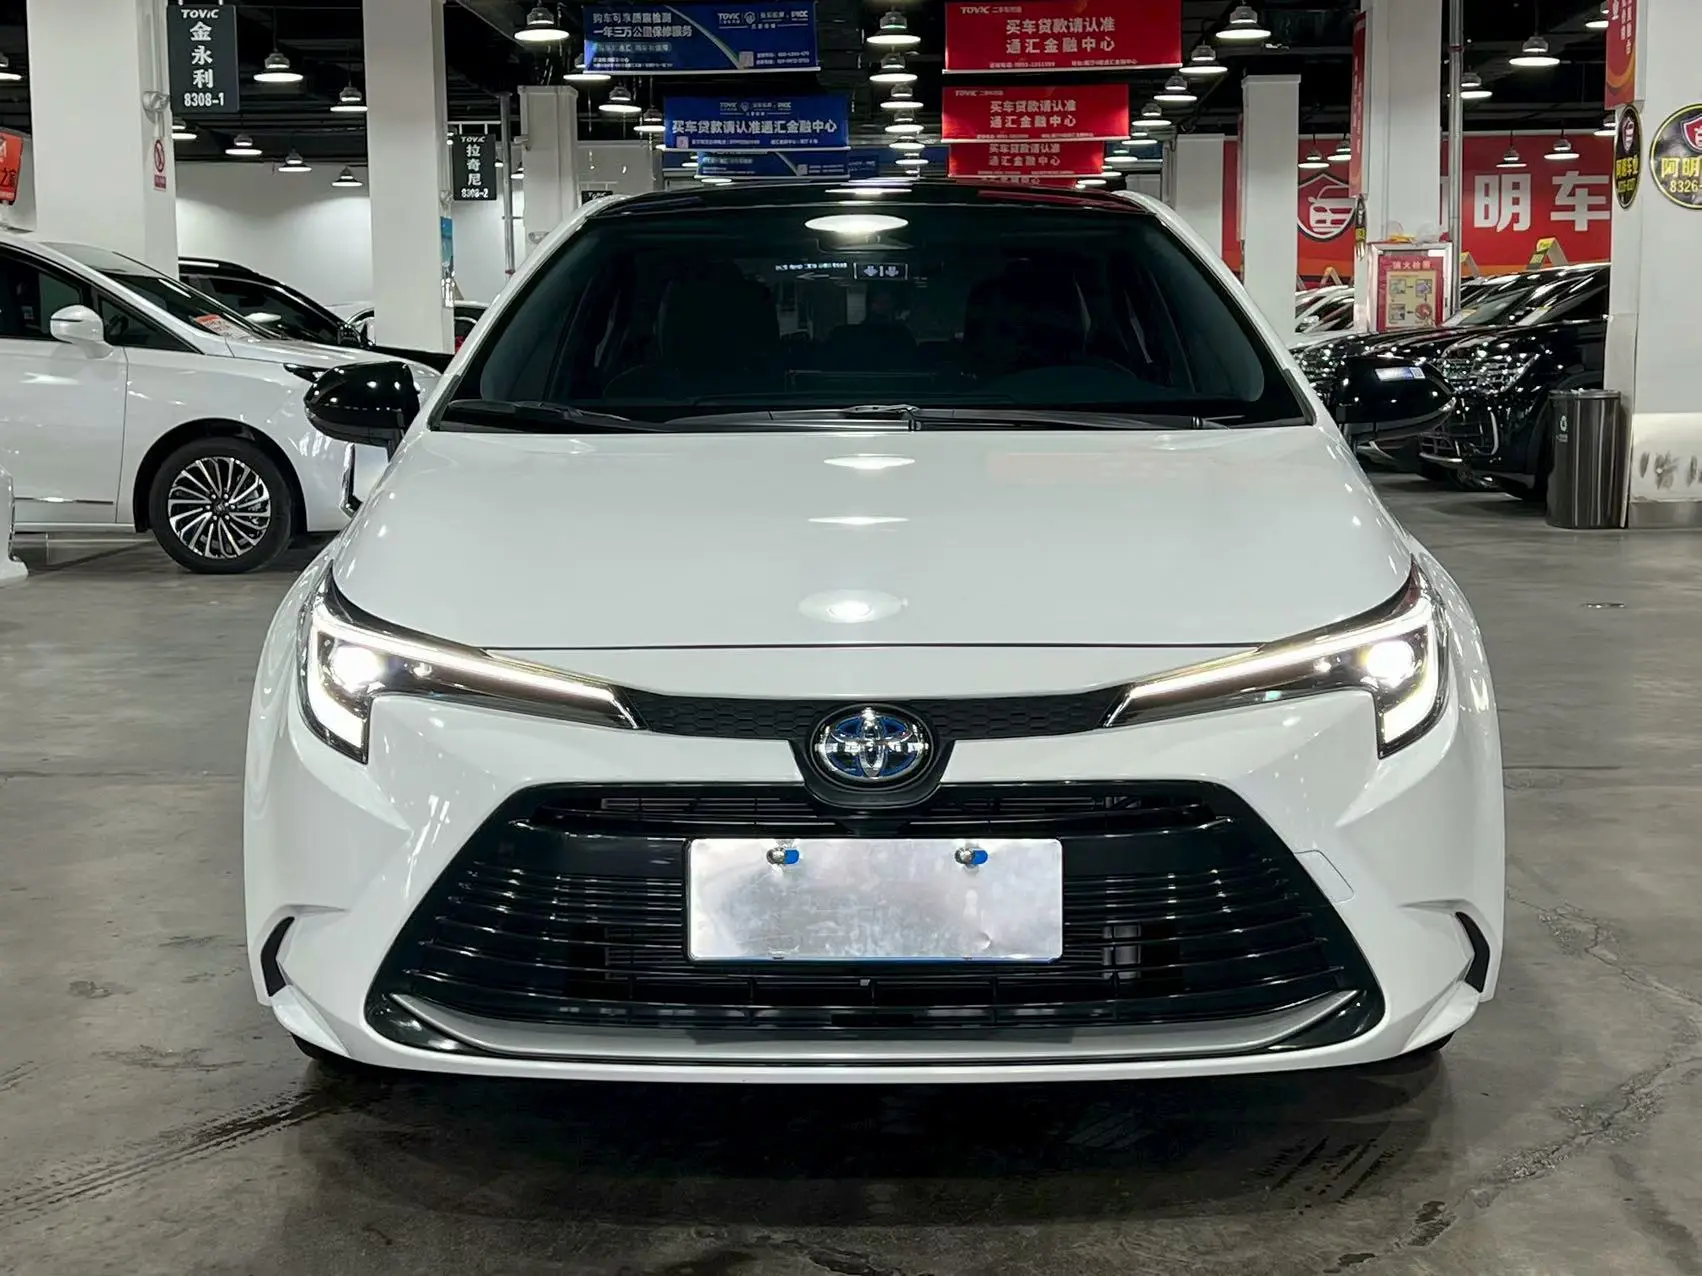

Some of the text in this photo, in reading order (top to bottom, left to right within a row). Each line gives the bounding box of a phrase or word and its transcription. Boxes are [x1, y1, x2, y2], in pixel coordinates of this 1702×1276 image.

[181, 9, 219, 18] TOVIC
[1006, 16, 1115, 35] 买车贷款请认准
[1006, 36, 1115, 54] 通汇金融中心
[190, 21, 214, 89] 金永利
[184, 92, 224, 107] 8308-1
[990, 100, 1077, 114] 买车贷款请认准
[672, 119, 838, 135] 买车贷款请认准通汇金融中心
[990, 115, 1076, 129] 通汇金融中心
[1661, 156, 1702, 178] 阿明
[1440, 170, 1611, 233] 明车
